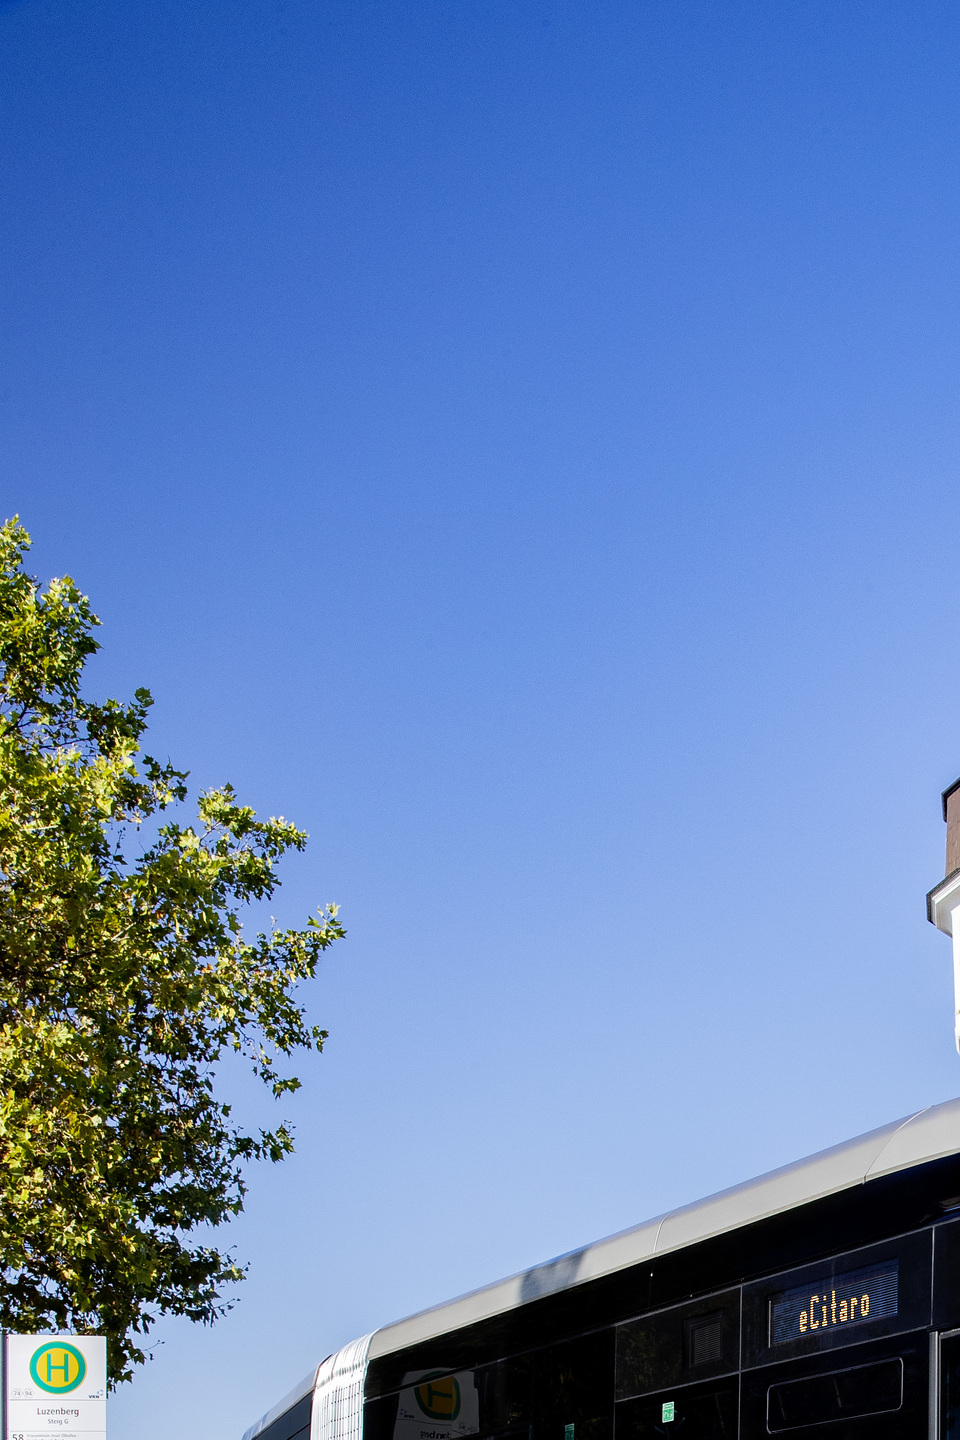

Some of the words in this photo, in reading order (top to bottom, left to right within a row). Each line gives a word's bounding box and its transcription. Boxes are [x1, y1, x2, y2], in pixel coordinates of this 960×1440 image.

[799, 1290, 870, 1332] eCitaro
[46, 1353, 69, 1382] H
[37, 1407, 80, 1417] Luzenberg
